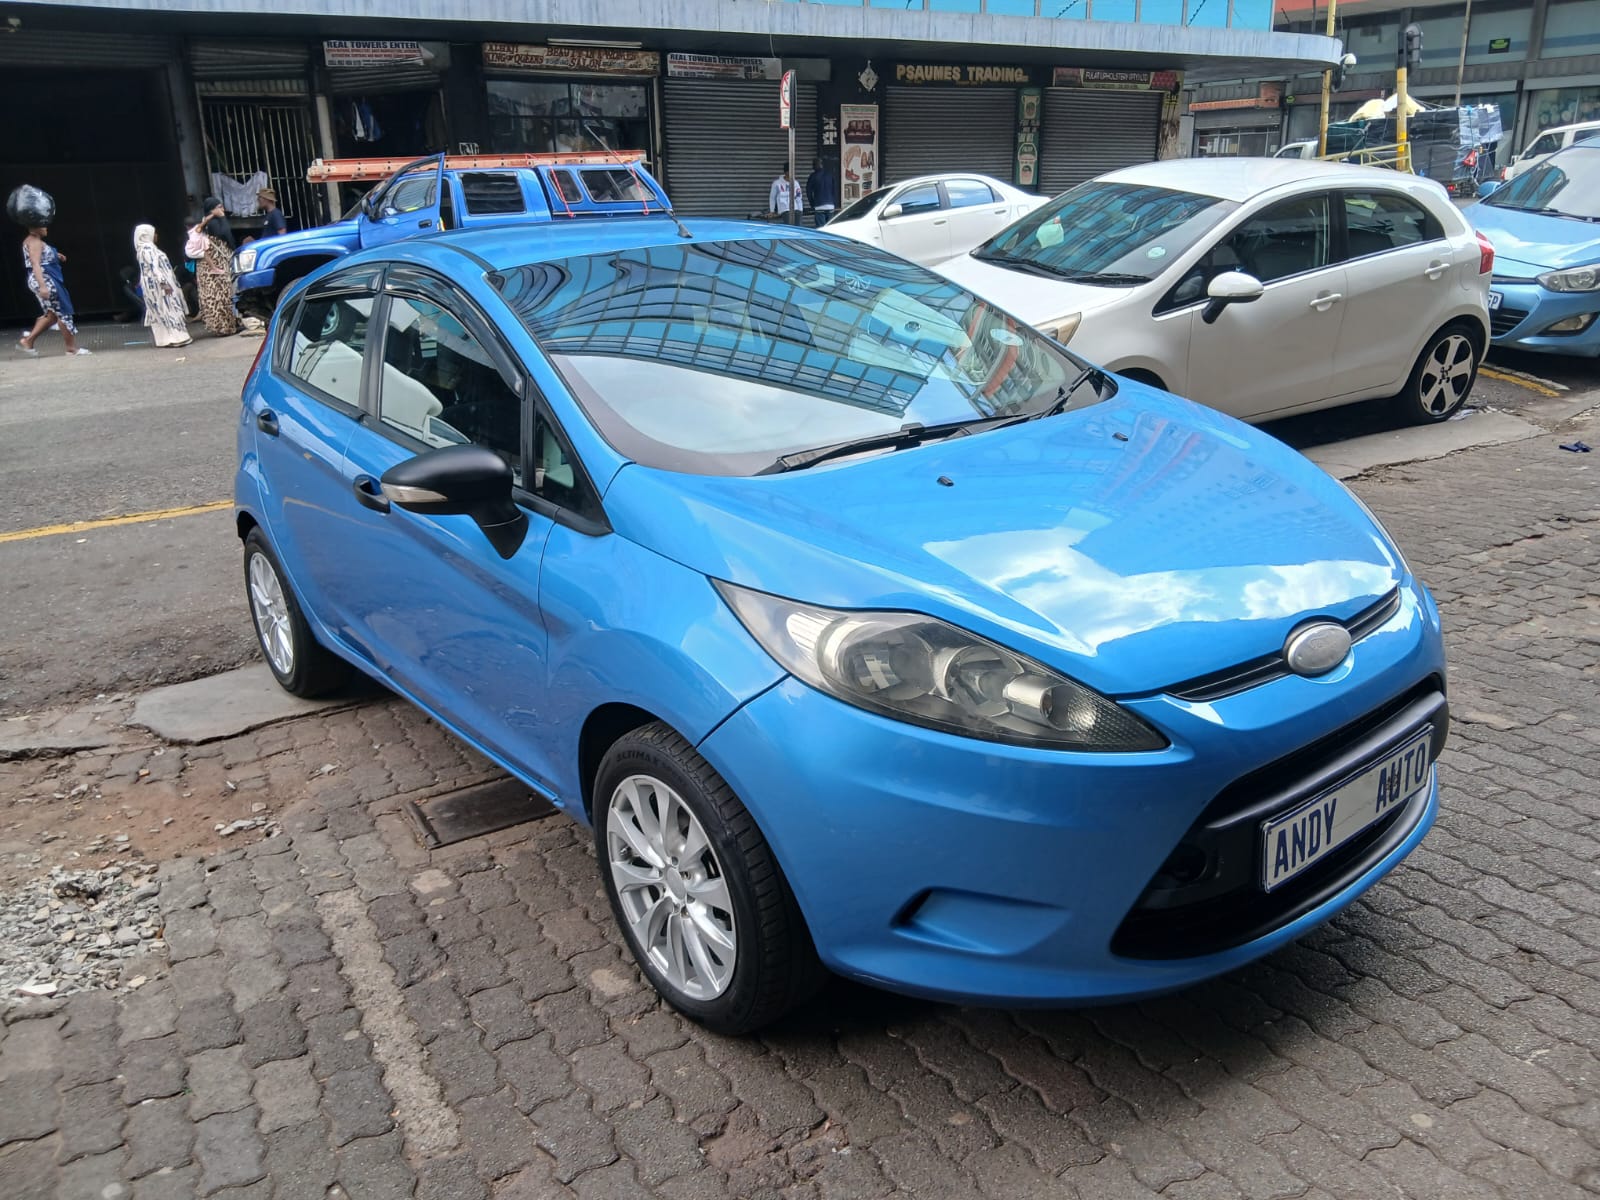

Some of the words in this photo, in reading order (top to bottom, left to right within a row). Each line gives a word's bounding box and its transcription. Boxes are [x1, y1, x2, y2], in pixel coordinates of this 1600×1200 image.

[351, 41, 388, 49] TOWERS
[896, 64, 961, 81] PSAUMES
[966, 66, 1024, 82] TRADING
[1274, 798, 1337, 878] ANDY
[1376, 742, 1426, 813] AUTO
